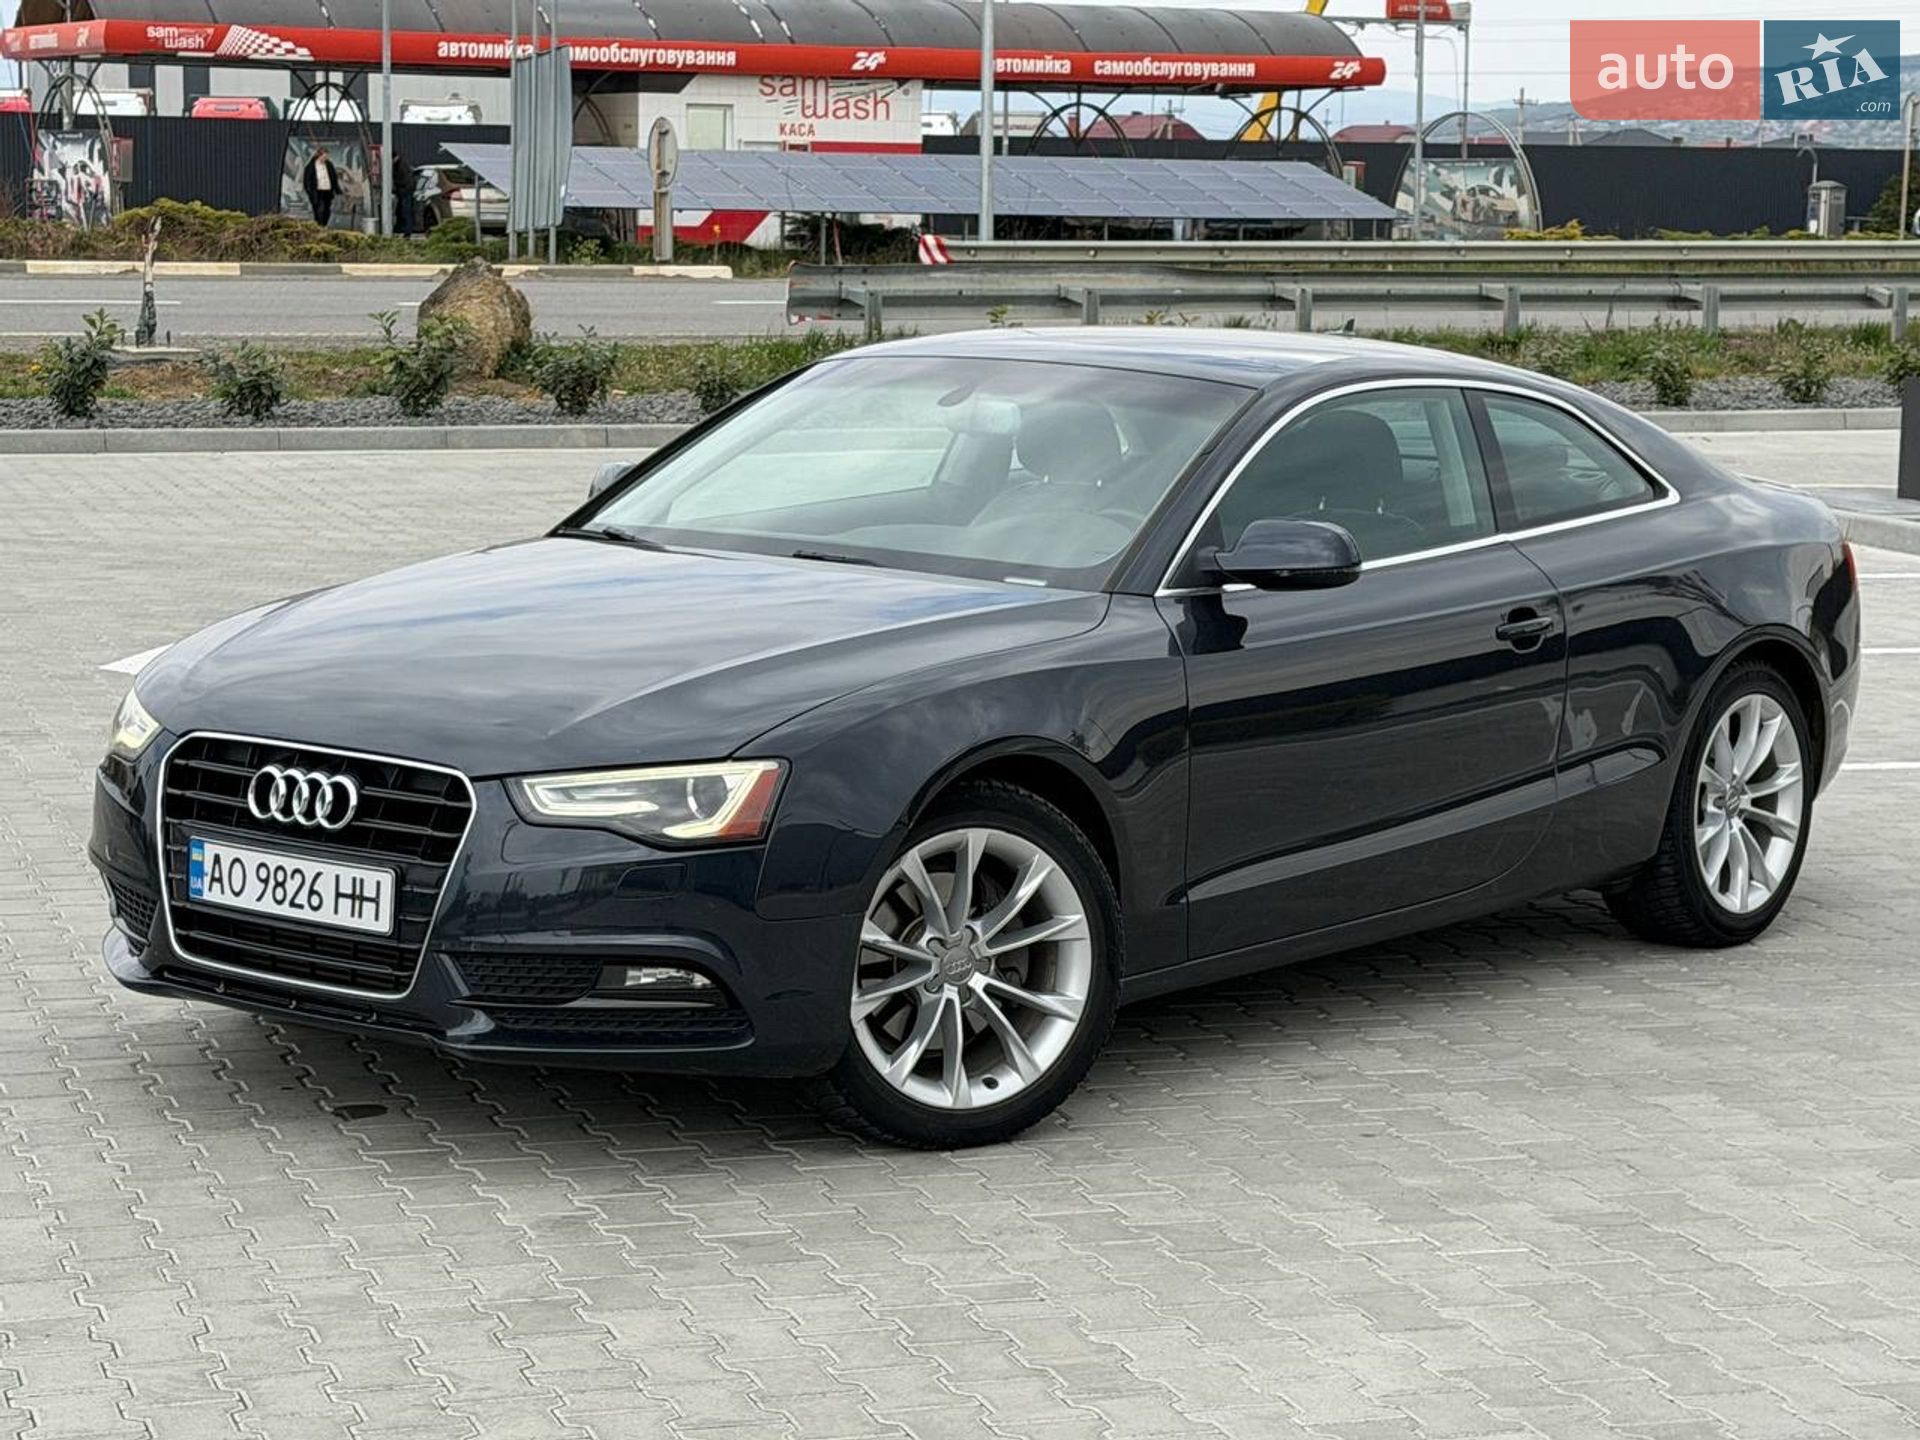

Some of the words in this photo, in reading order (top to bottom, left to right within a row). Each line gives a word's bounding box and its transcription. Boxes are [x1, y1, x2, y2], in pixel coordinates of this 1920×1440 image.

[146, 25, 179, 38] sam
[164, 33, 205, 49] wash
[569, 42, 737, 68] мообслуговування
[994, 54, 1072, 75] втомийка
[1093, 57, 1256, 80] самообслуговування
[779, 122, 816, 137] КАСА
[208, 852, 247, 898] AO
[255, 861, 324, 912] 9826
[332, 873, 382, 923] HH
